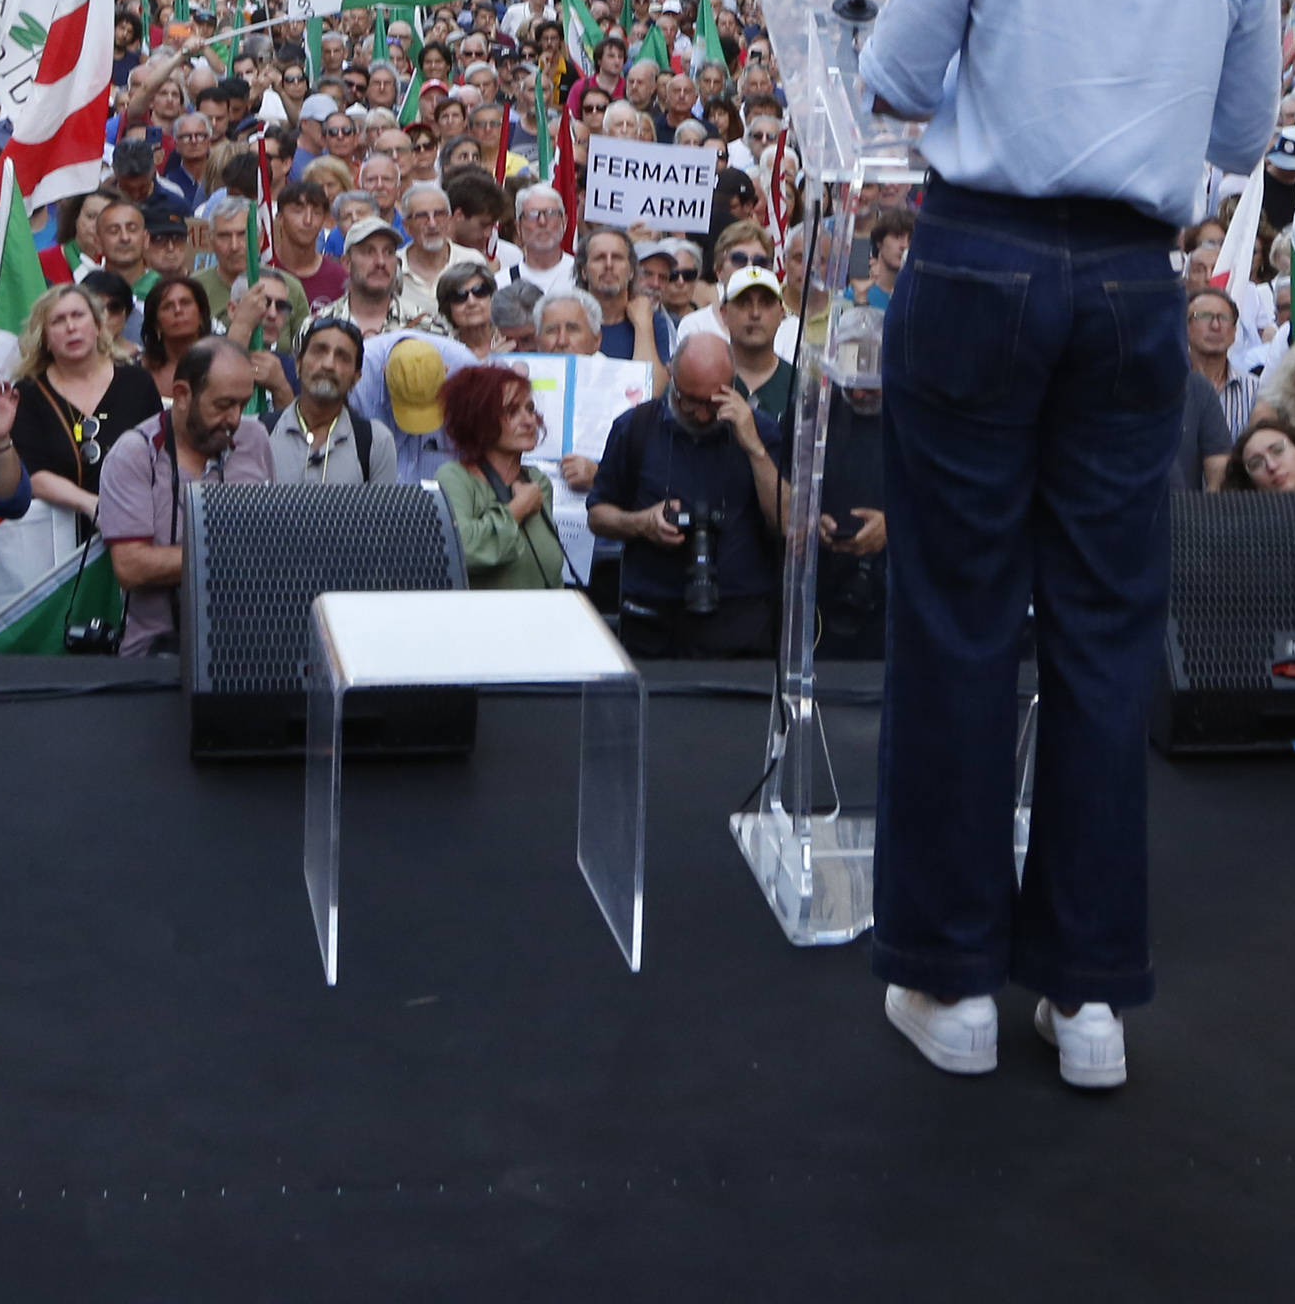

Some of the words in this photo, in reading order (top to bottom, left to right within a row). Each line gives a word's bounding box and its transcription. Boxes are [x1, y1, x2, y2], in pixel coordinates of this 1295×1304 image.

[593, 154, 710, 186] FERMATE
[593, 188, 625, 213] LE
[639, 196, 705, 219] ARMI
